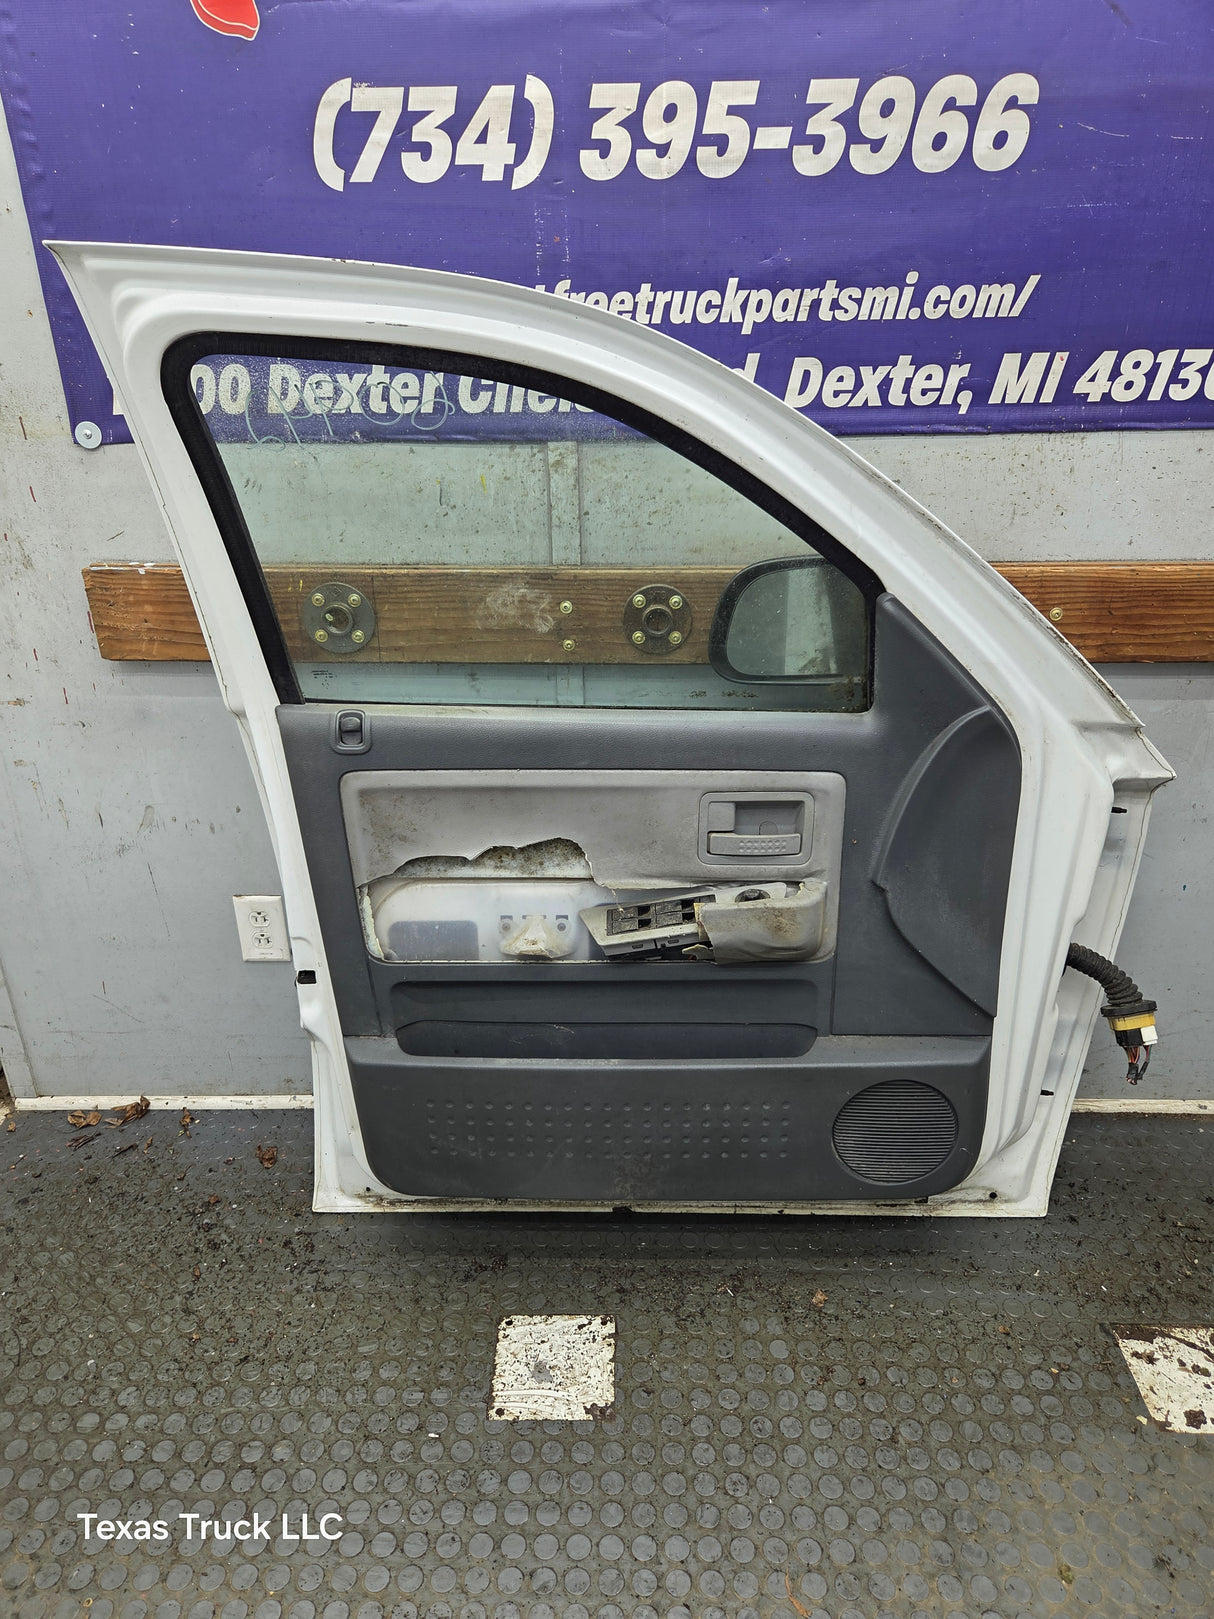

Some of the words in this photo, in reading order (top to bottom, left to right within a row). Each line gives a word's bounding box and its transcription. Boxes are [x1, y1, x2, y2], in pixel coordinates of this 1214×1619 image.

[313, 74, 555, 192] (734)
[579, 73, 1040, 181] 395-3966
[535, 271, 1041, 335] eetruckpartsmi.com/
[268, 364, 444, 414] Dexter
[784, 355, 971, 415] Dexter,
[988, 351, 1069, 405] MI
